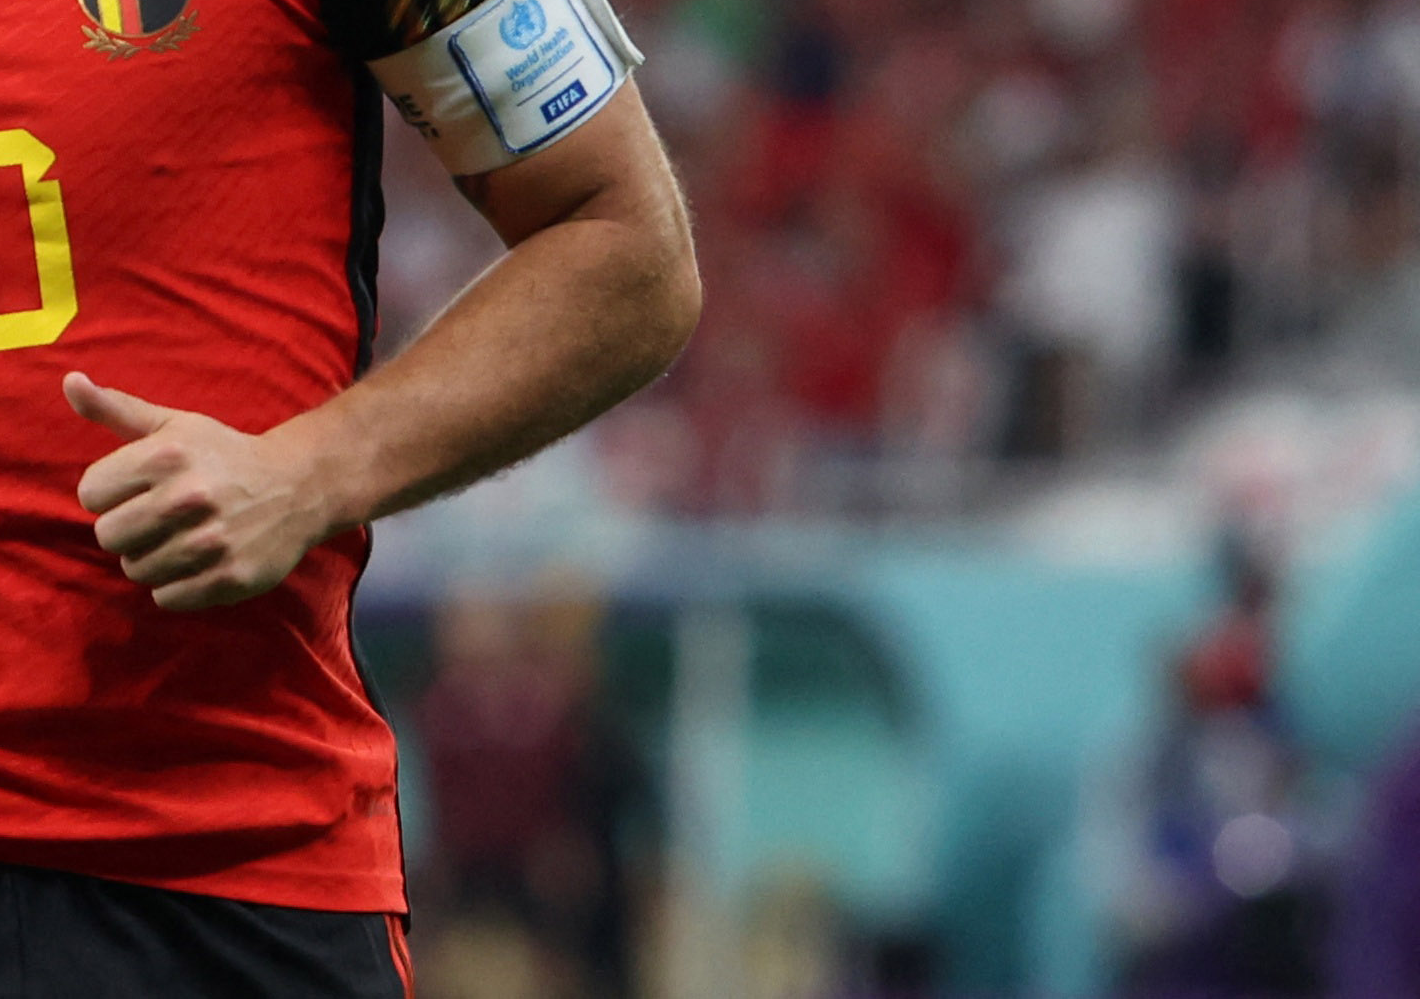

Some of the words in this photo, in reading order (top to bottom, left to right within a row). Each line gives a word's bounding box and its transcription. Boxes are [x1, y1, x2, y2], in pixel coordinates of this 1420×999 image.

[505, 50, 540, 81] World
[539, 27, 570, 57] Health
[511, 40, 576, 93] Organization
[547, 87, 581, 117] FIFA
